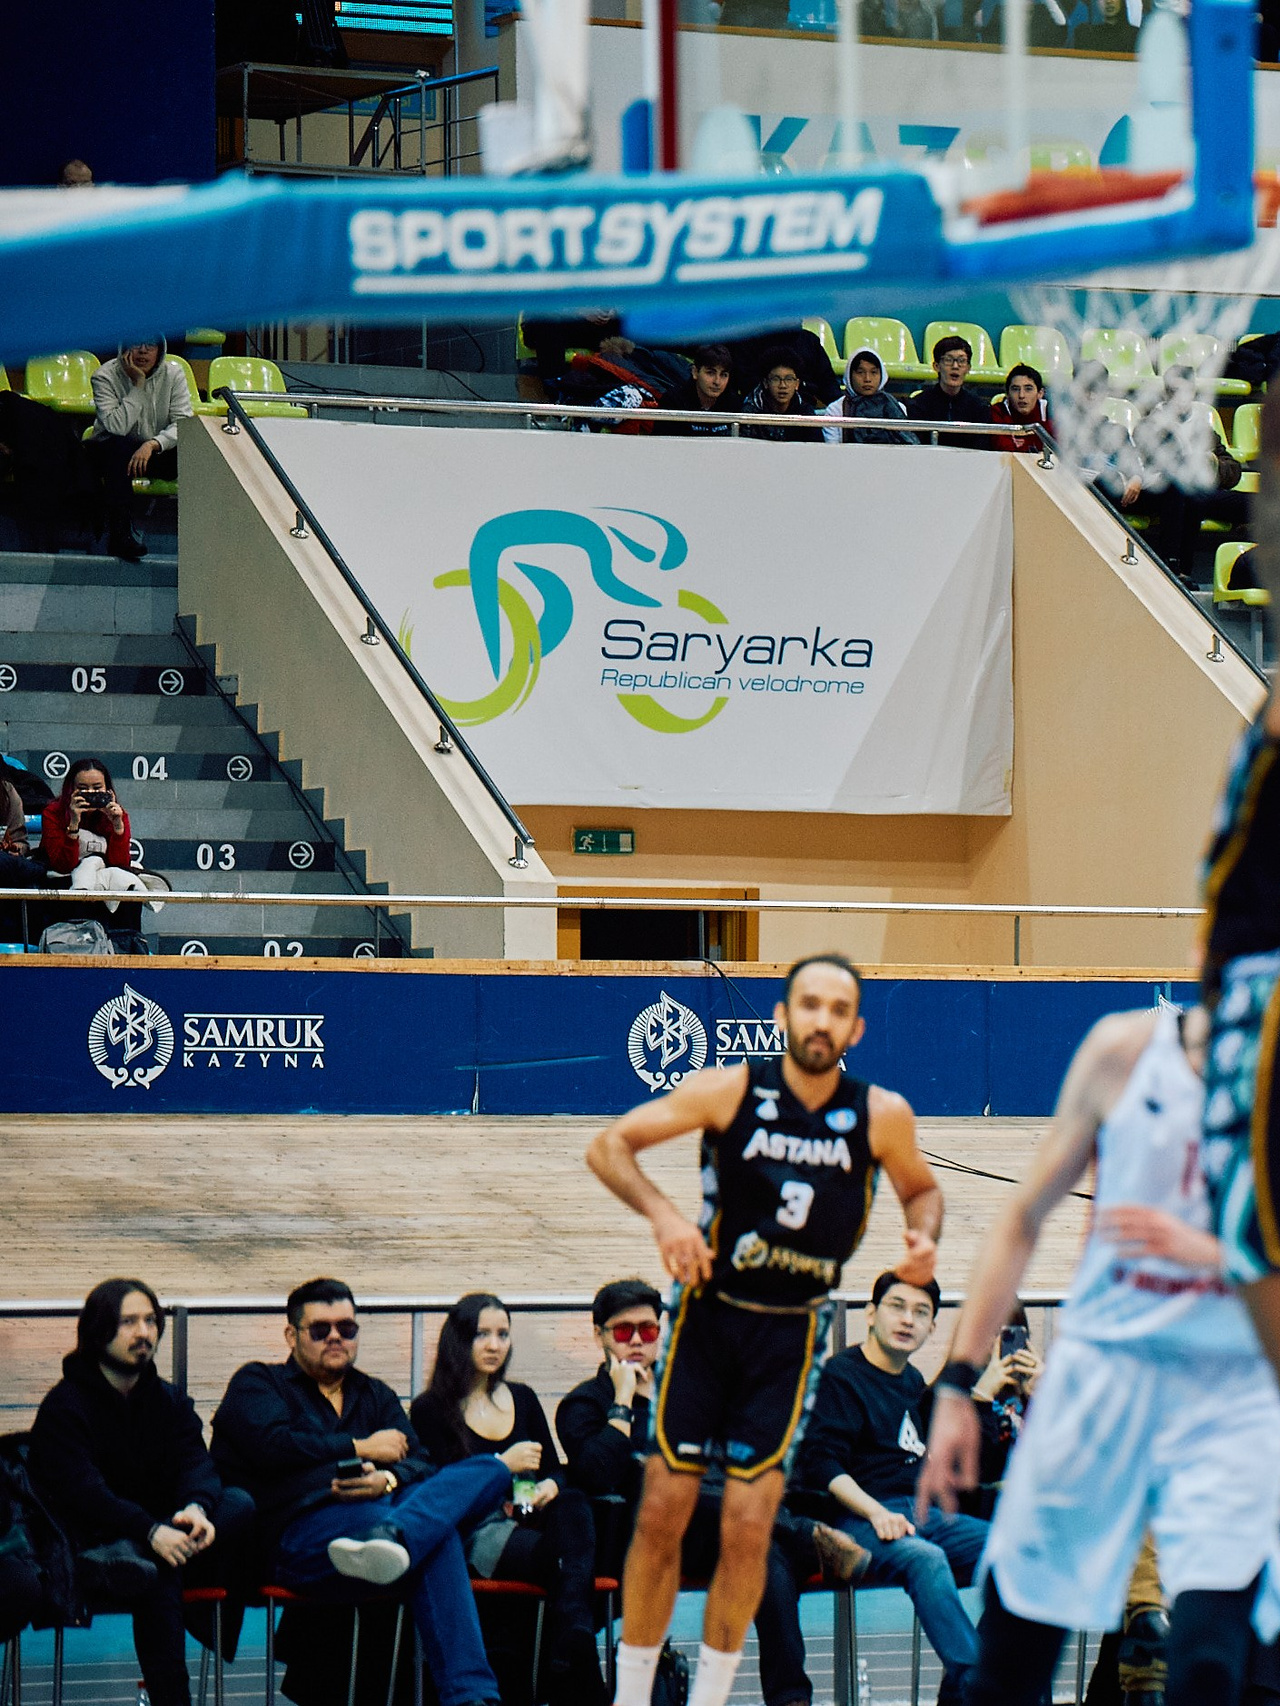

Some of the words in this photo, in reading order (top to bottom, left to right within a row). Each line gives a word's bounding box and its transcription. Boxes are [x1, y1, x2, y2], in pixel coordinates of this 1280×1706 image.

[601, 619, 873, 675] Saryarka
[71, 667, 107, 694] 05
[600, 668, 731, 691] Republican
[738, 674, 865, 695] velodrome
[132, 756, 168, 781] 04
[196, 843, 236, 871] 03
[183, 1018, 325, 1047] SAMRUK
[182, 1053, 325, 1068] KAZYNA
[742, 1128, 852, 1173] ASTANA
[775, 1180, 815, 1231] 3
